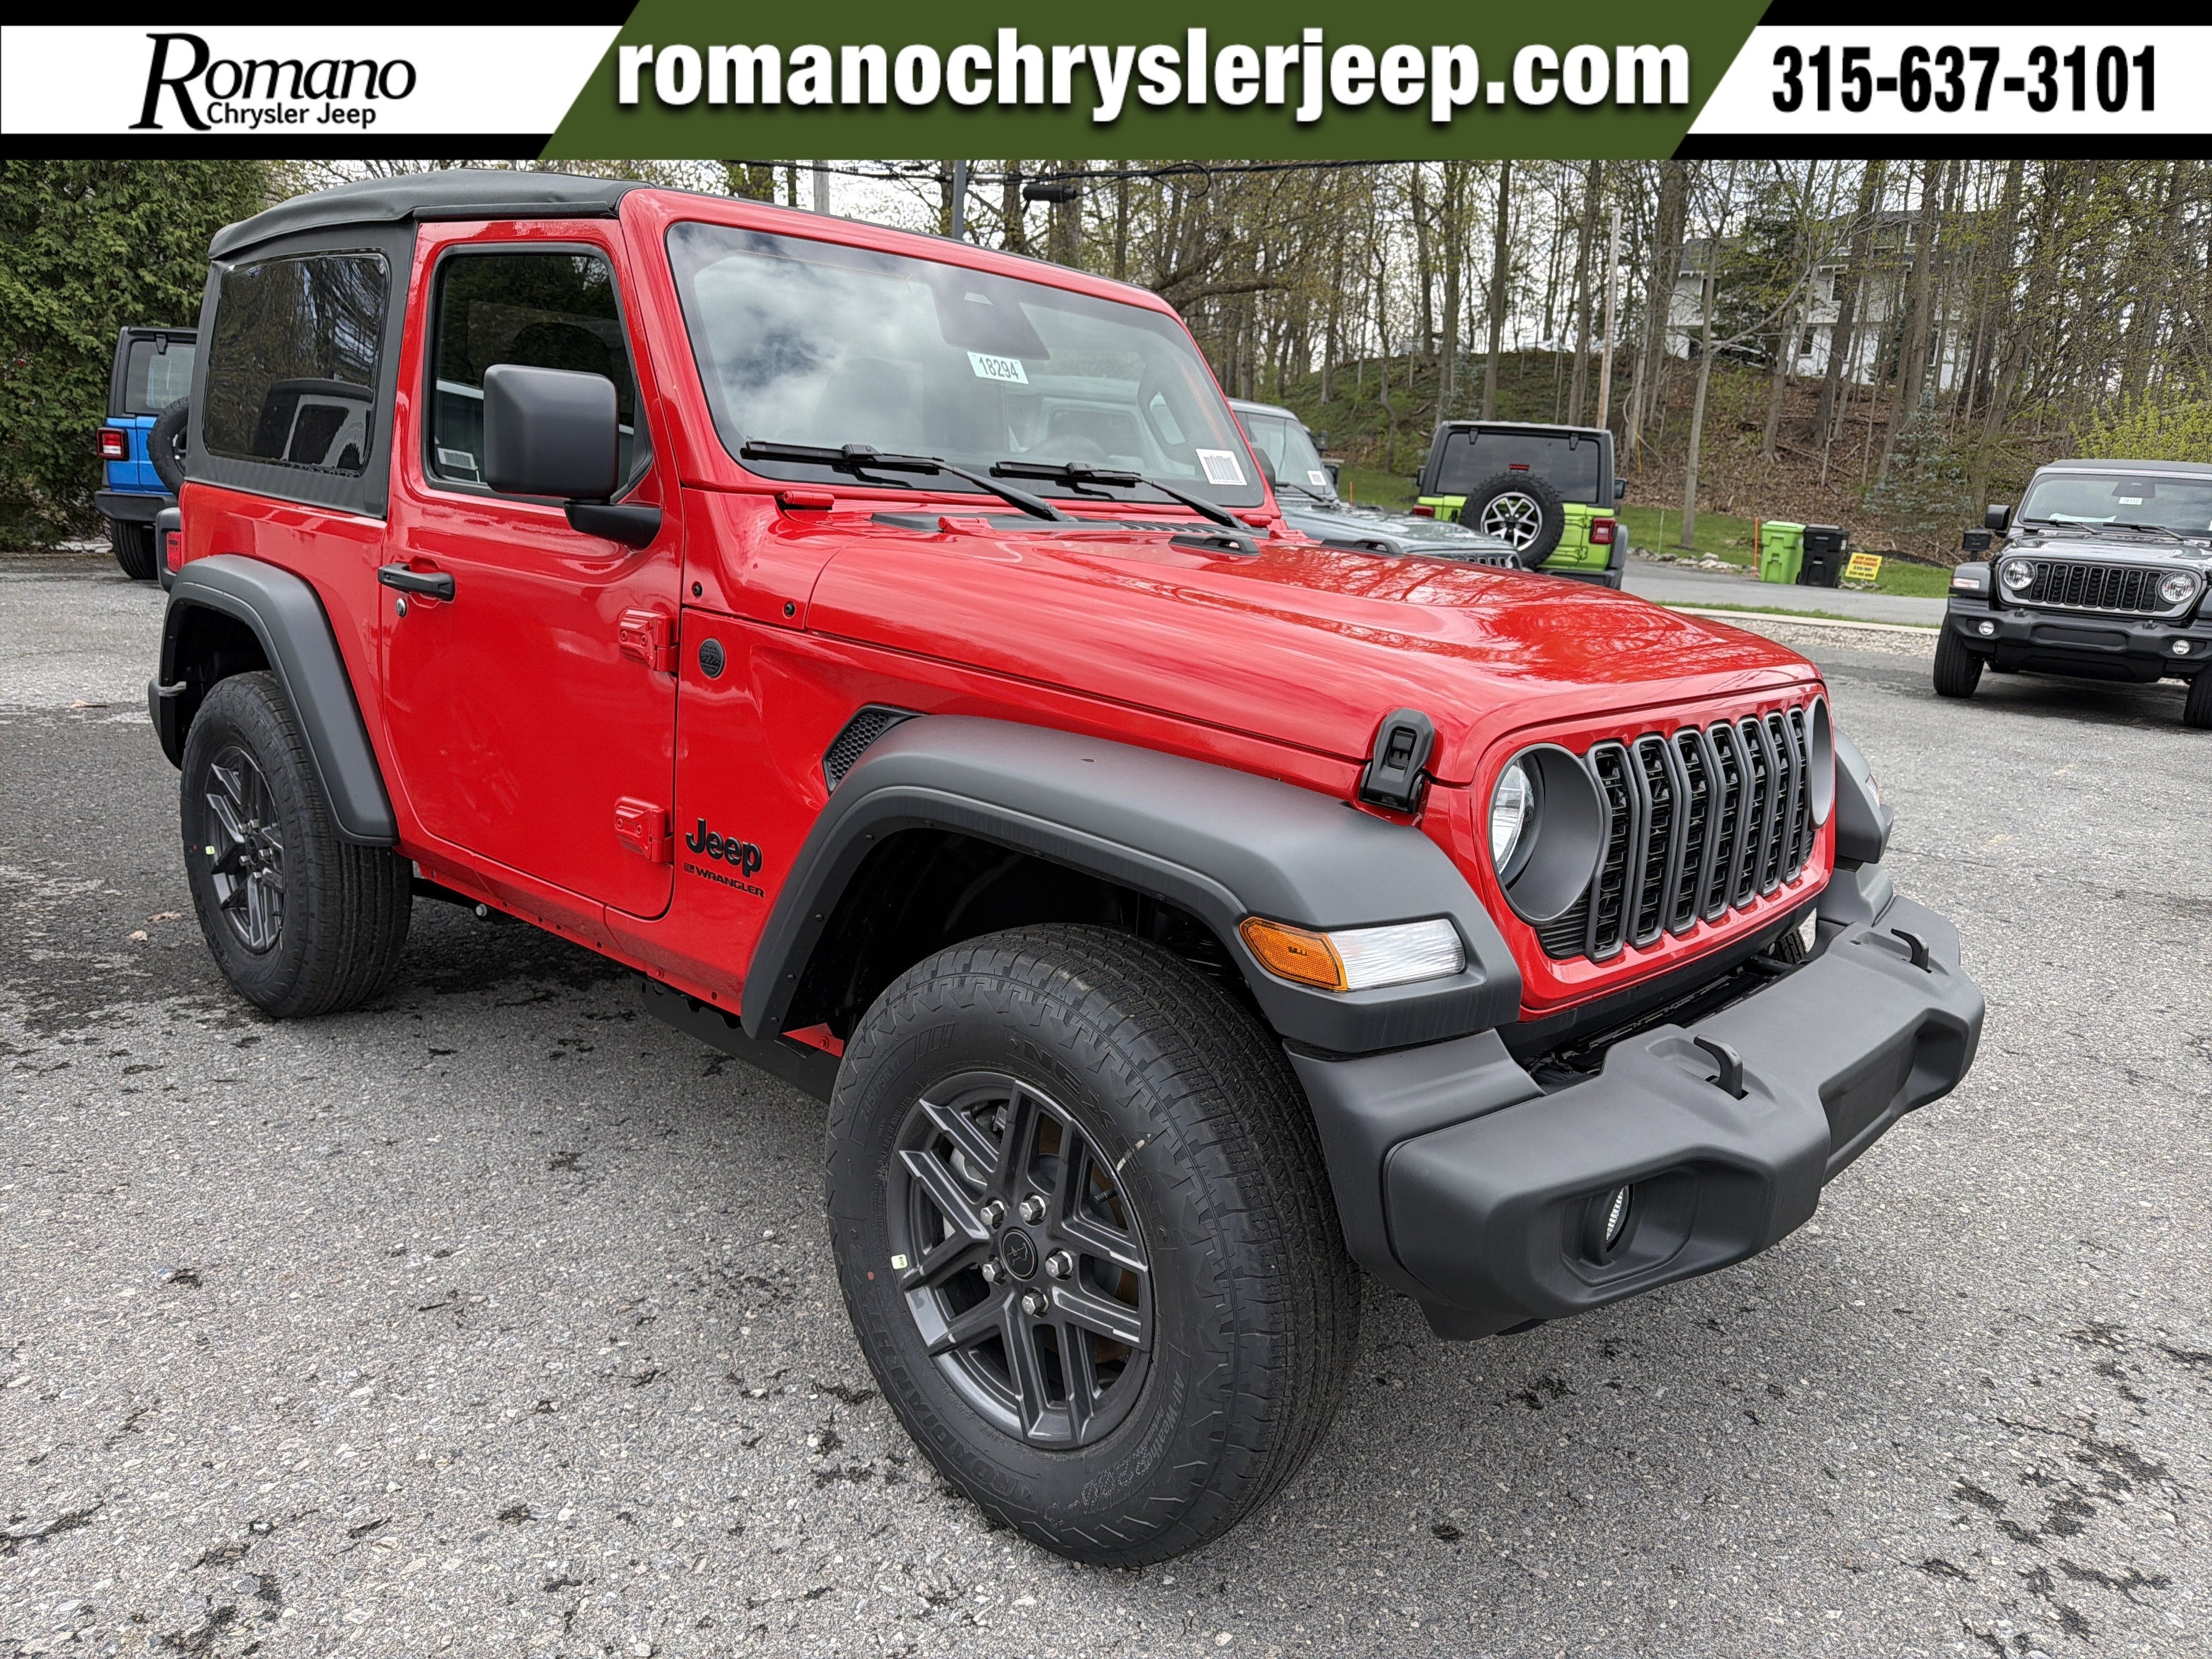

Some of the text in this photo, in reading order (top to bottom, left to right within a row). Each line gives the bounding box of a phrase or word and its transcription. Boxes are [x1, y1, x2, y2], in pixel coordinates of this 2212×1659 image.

[979, 357, 1019, 380] 18294
[686, 817, 761, 878] Jeep
[695, 866, 764, 898] WRANGLER
